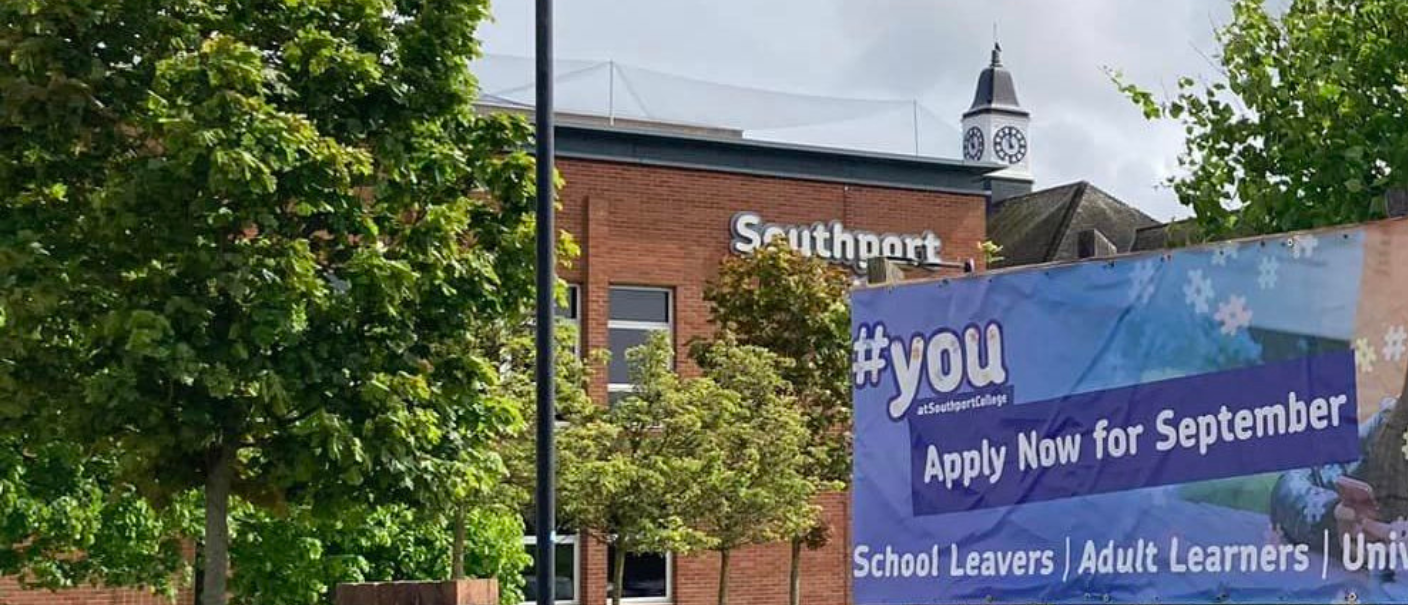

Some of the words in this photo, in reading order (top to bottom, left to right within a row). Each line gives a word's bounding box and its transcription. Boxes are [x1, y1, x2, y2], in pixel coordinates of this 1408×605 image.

[732, 212, 942, 270] Southport
[923, 438, 1007, 489] Apply
[1017, 429, 1081, 471] Now
[1093, 419, 1144, 460] for
[1155, 391, 1348, 455] September
[853, 544, 939, 577] School
[949, 542, 1055, 576] Leavers
[1077, 536, 1158, 575] Adult
[1169, 536, 1310, 573] Learners
